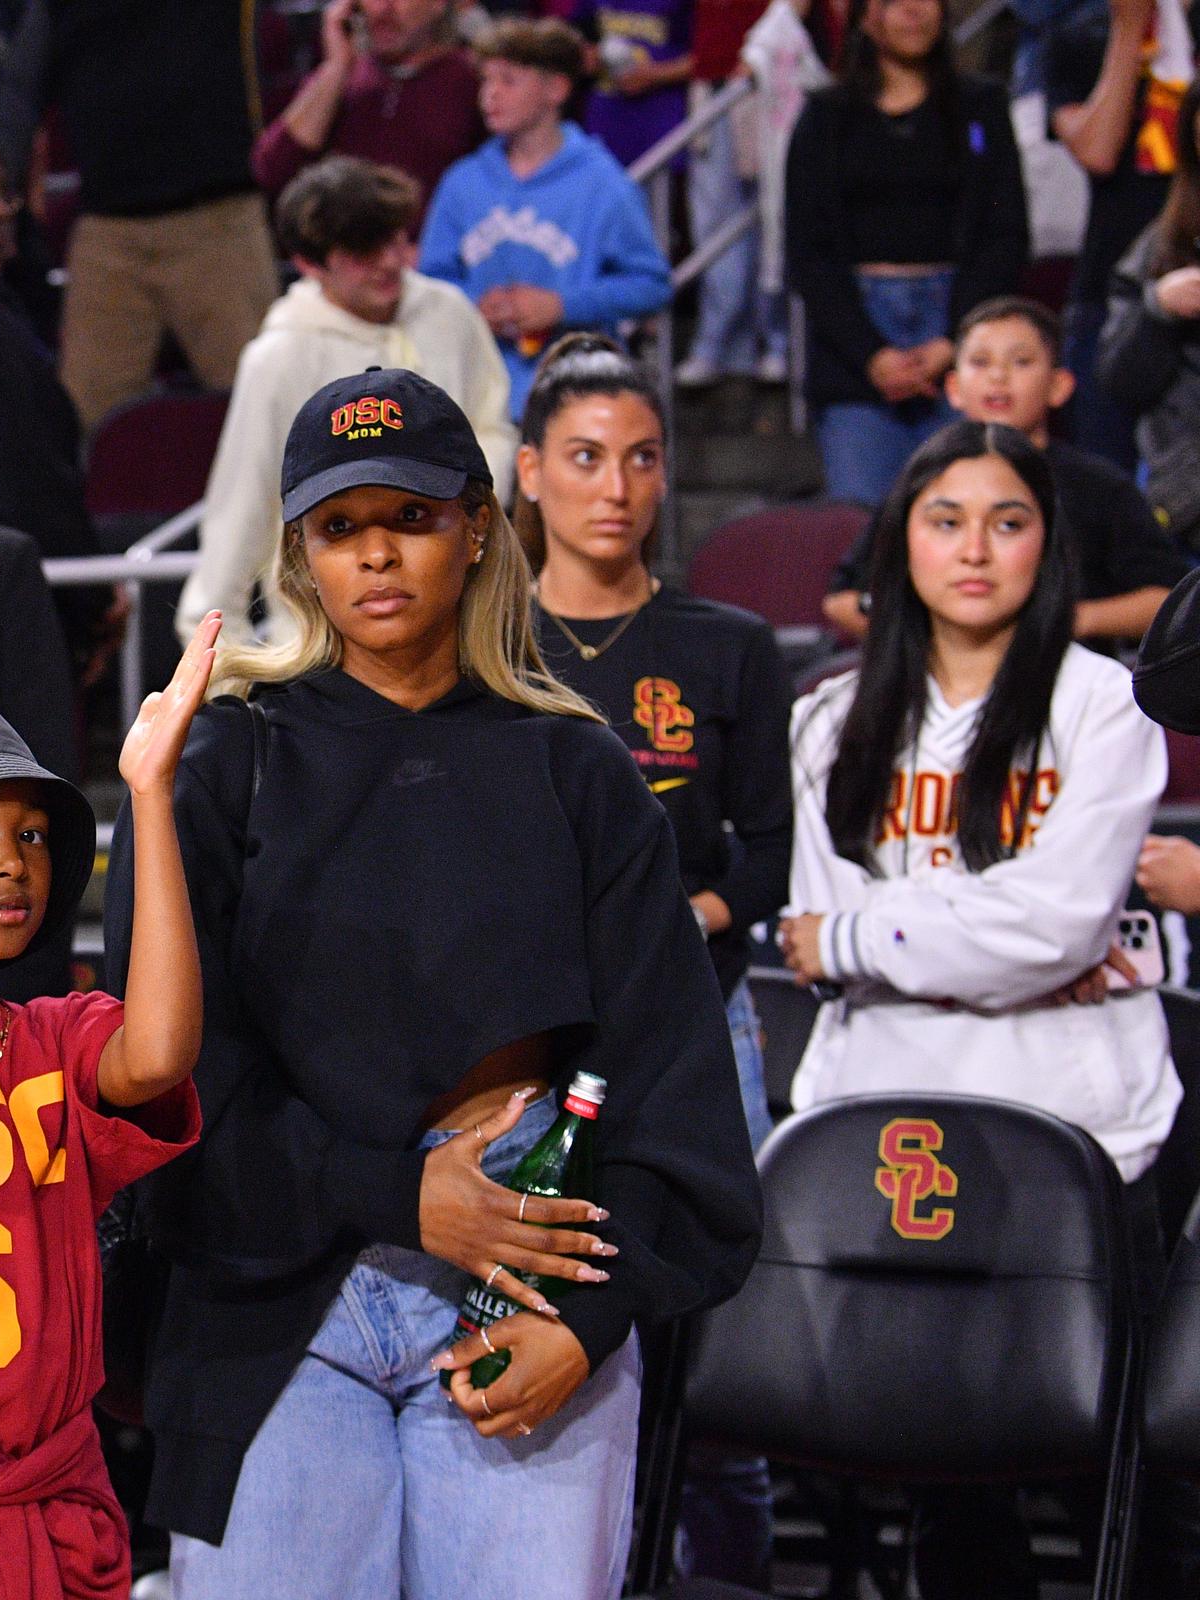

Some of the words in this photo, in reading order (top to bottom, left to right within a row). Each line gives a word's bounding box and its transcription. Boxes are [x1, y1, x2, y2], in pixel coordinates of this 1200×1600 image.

[331, 396, 404, 436] USC
[347, 427, 383, 441] MOM
[874, 1117, 959, 1241] SC
